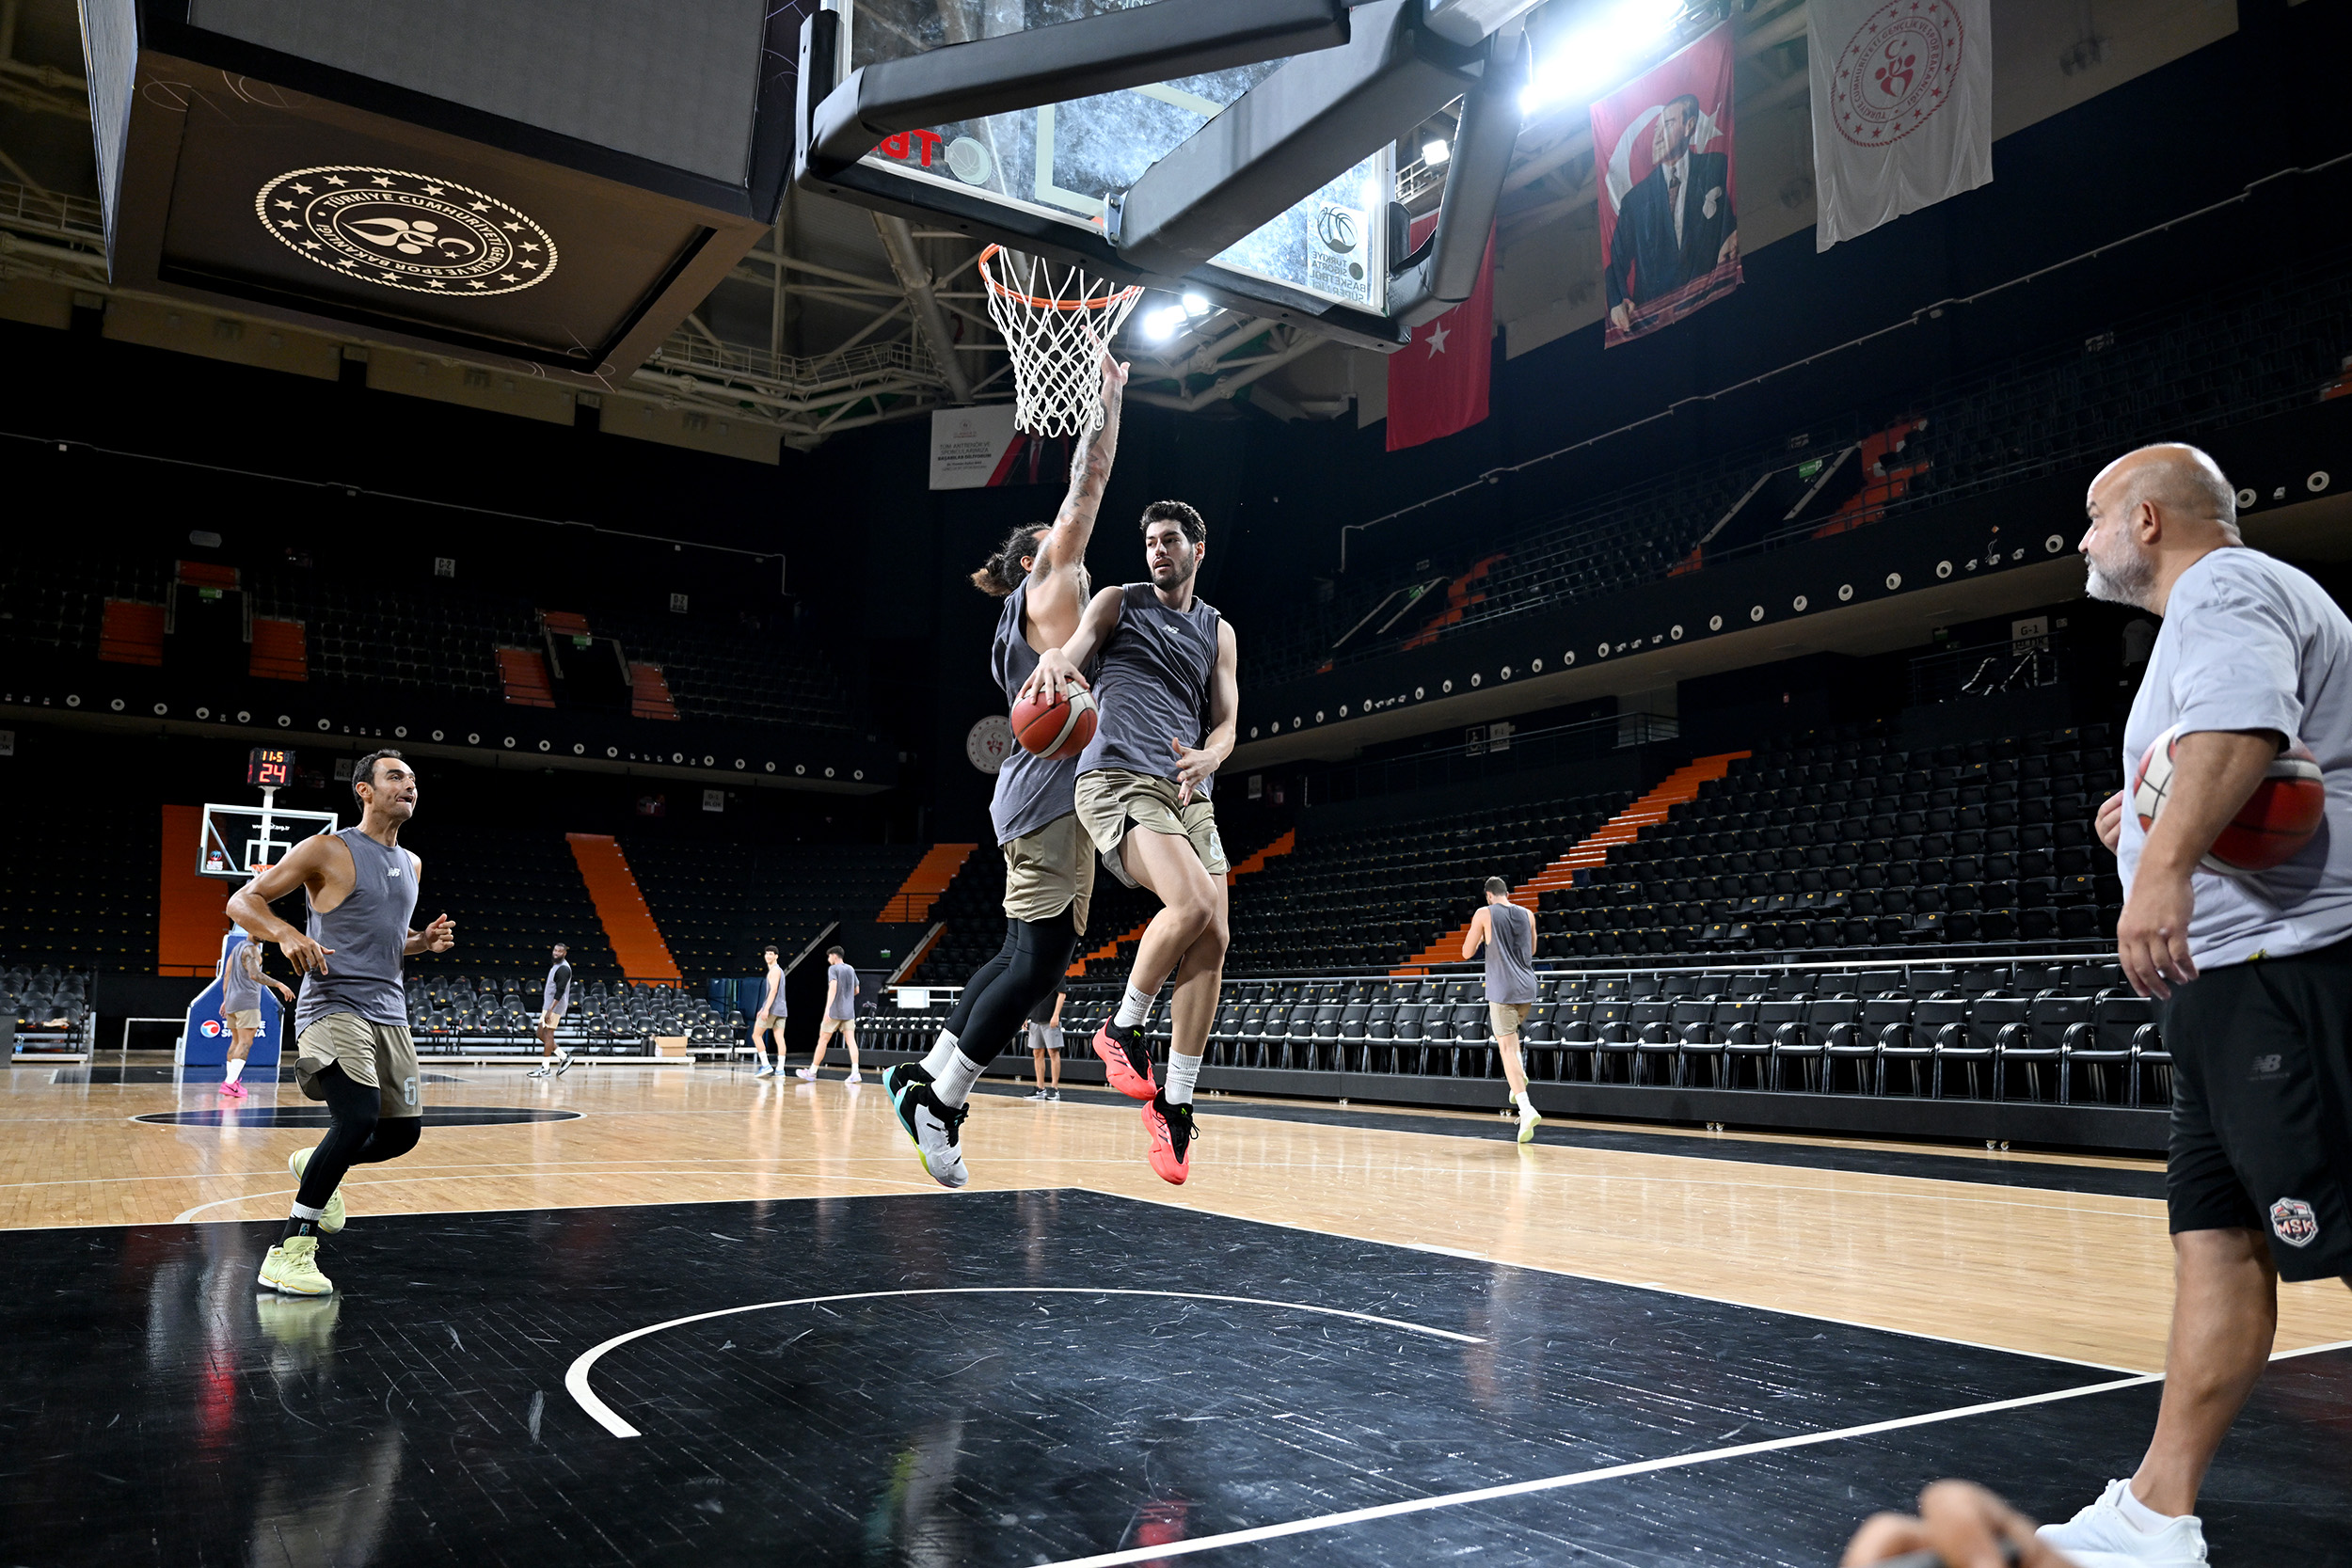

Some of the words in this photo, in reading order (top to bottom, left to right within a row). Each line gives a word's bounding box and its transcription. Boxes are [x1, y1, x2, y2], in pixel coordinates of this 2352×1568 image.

[1919, 23, 1929, 32] VE
[1926, 29, 1939, 51] SPOR
[323, 191, 394, 208] TÜRKİYE
[399, 196, 506, 245] CUMHURİYETİ
[316, 224, 390, 267] BAKANLIĞI
[395, 262, 443, 276] SPOR
[467, 246, 504, 273] GENÇLİK
[2021, 625, 2039, 636] G-1
[259, 763, 287, 784] 24
[405, 1076, 417, 1105] 6
[2277, 1219, 2316, 1234] MSK
